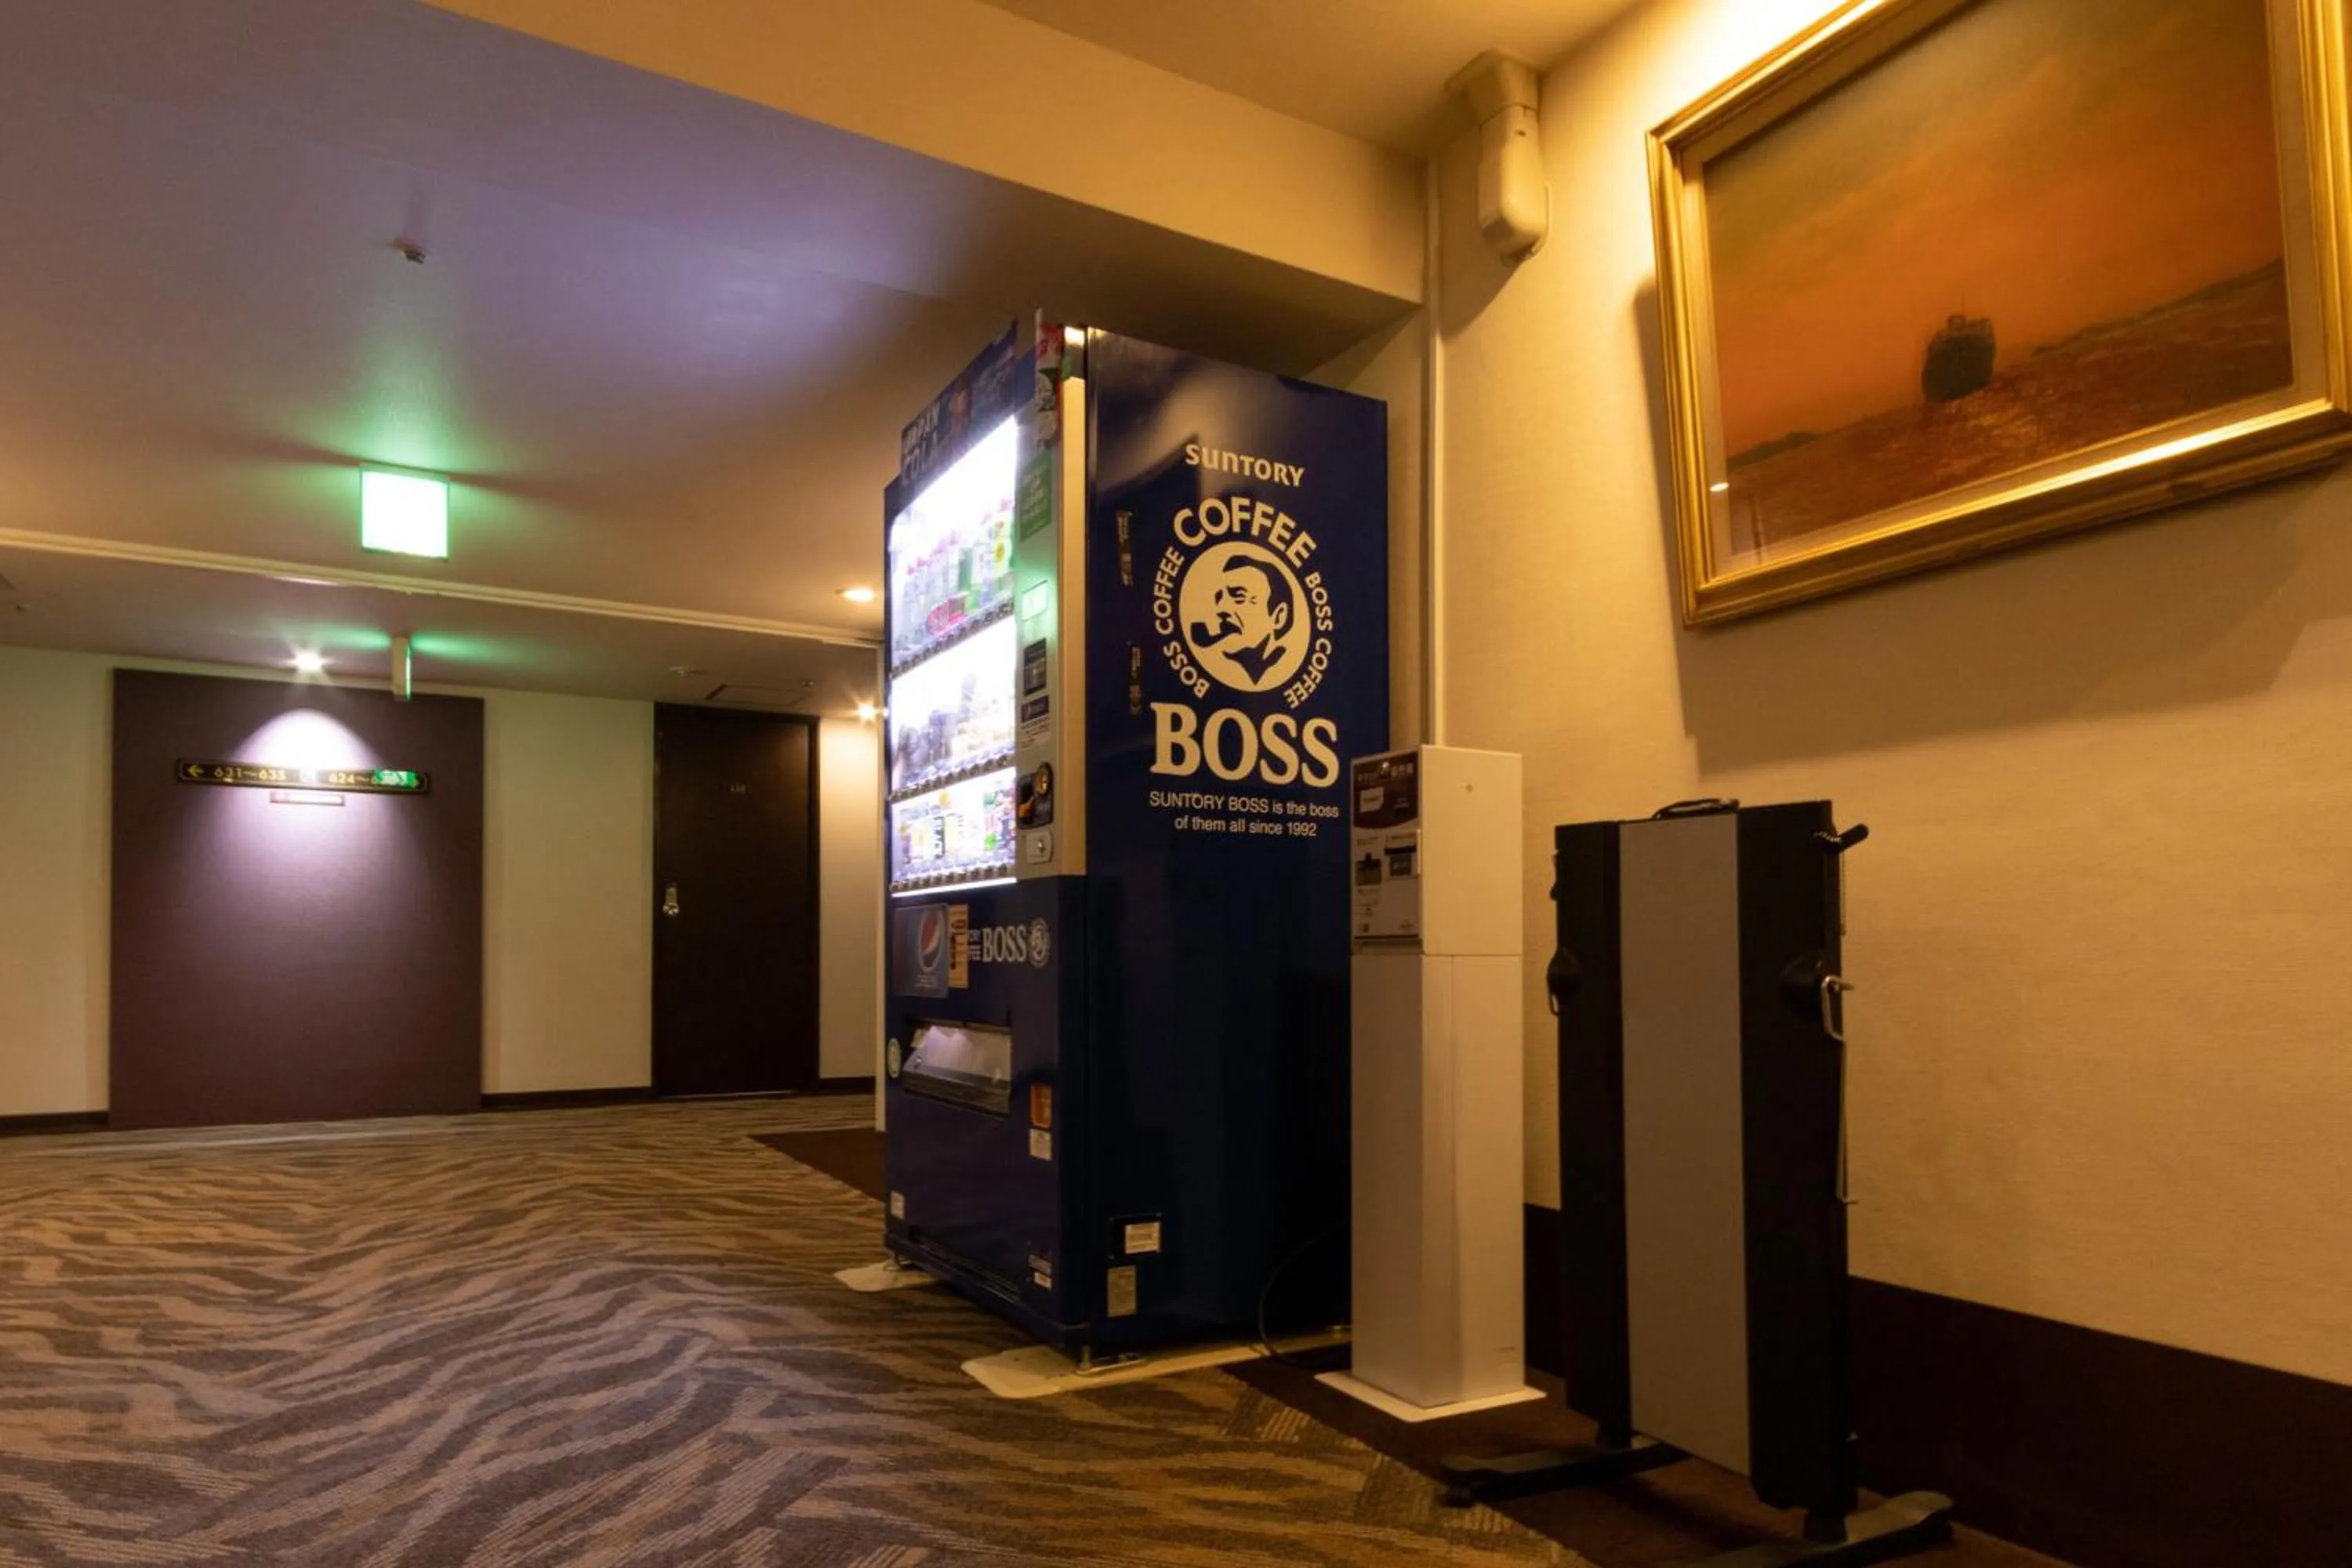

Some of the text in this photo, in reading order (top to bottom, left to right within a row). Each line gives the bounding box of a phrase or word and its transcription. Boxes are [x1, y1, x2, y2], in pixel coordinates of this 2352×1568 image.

[1174, 495, 1317, 568] COFFEE
[1153, 546, 1210, 699] BOSS COFFEE
[1283, 572, 1333, 709] BOSS COFFEE
[1149, 702, 1340, 788] BOSS
[1149, 790, 1339, 818] SUNTORY BOSS is the boss
[1174, 815, 1317, 837] of them all since 1992
[982, 925, 1027, 963] BOSS
